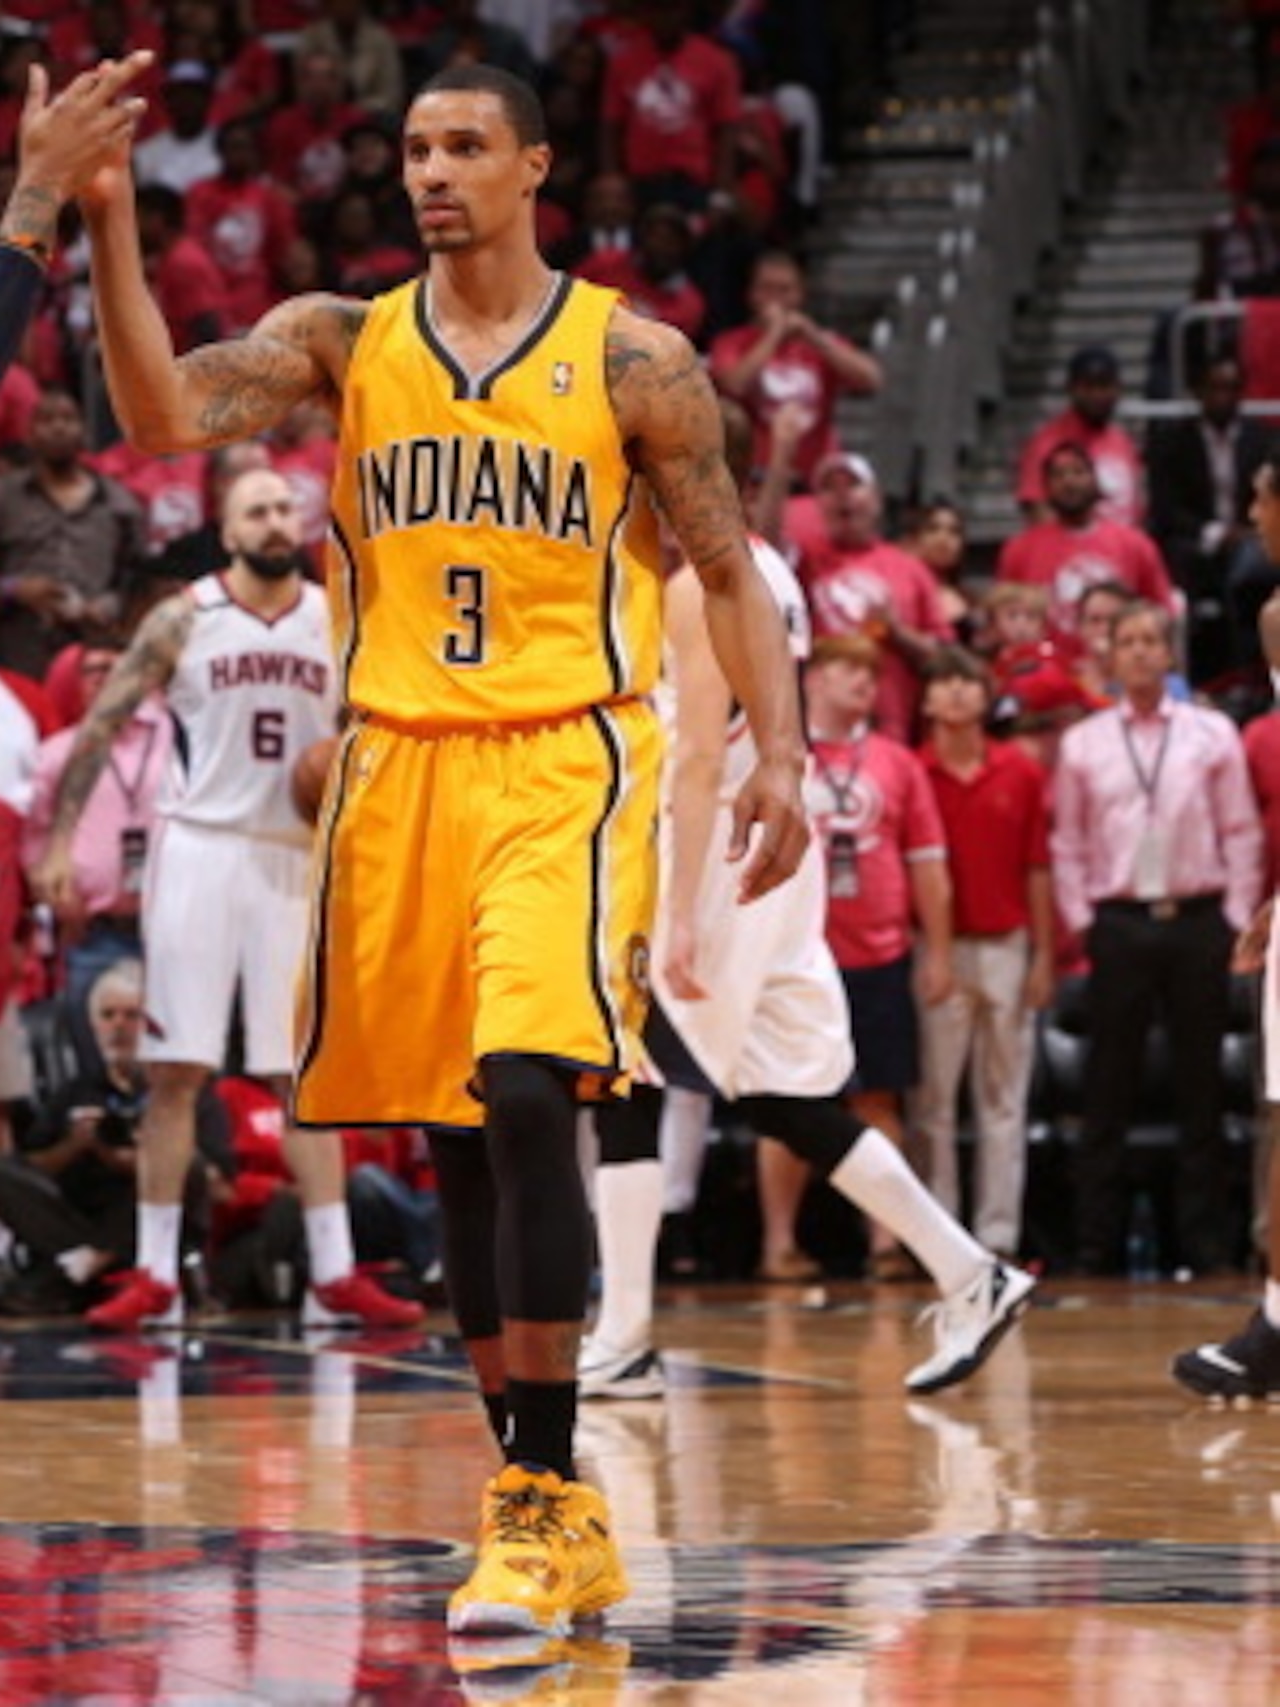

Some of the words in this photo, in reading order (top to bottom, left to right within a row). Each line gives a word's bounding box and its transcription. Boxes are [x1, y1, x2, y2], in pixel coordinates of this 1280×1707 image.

[356, 436, 595, 548] INDIANA
[444, 566, 486, 666] 3
[209, 651, 327, 696] HAWKS
[252, 710, 285, 760] 6
